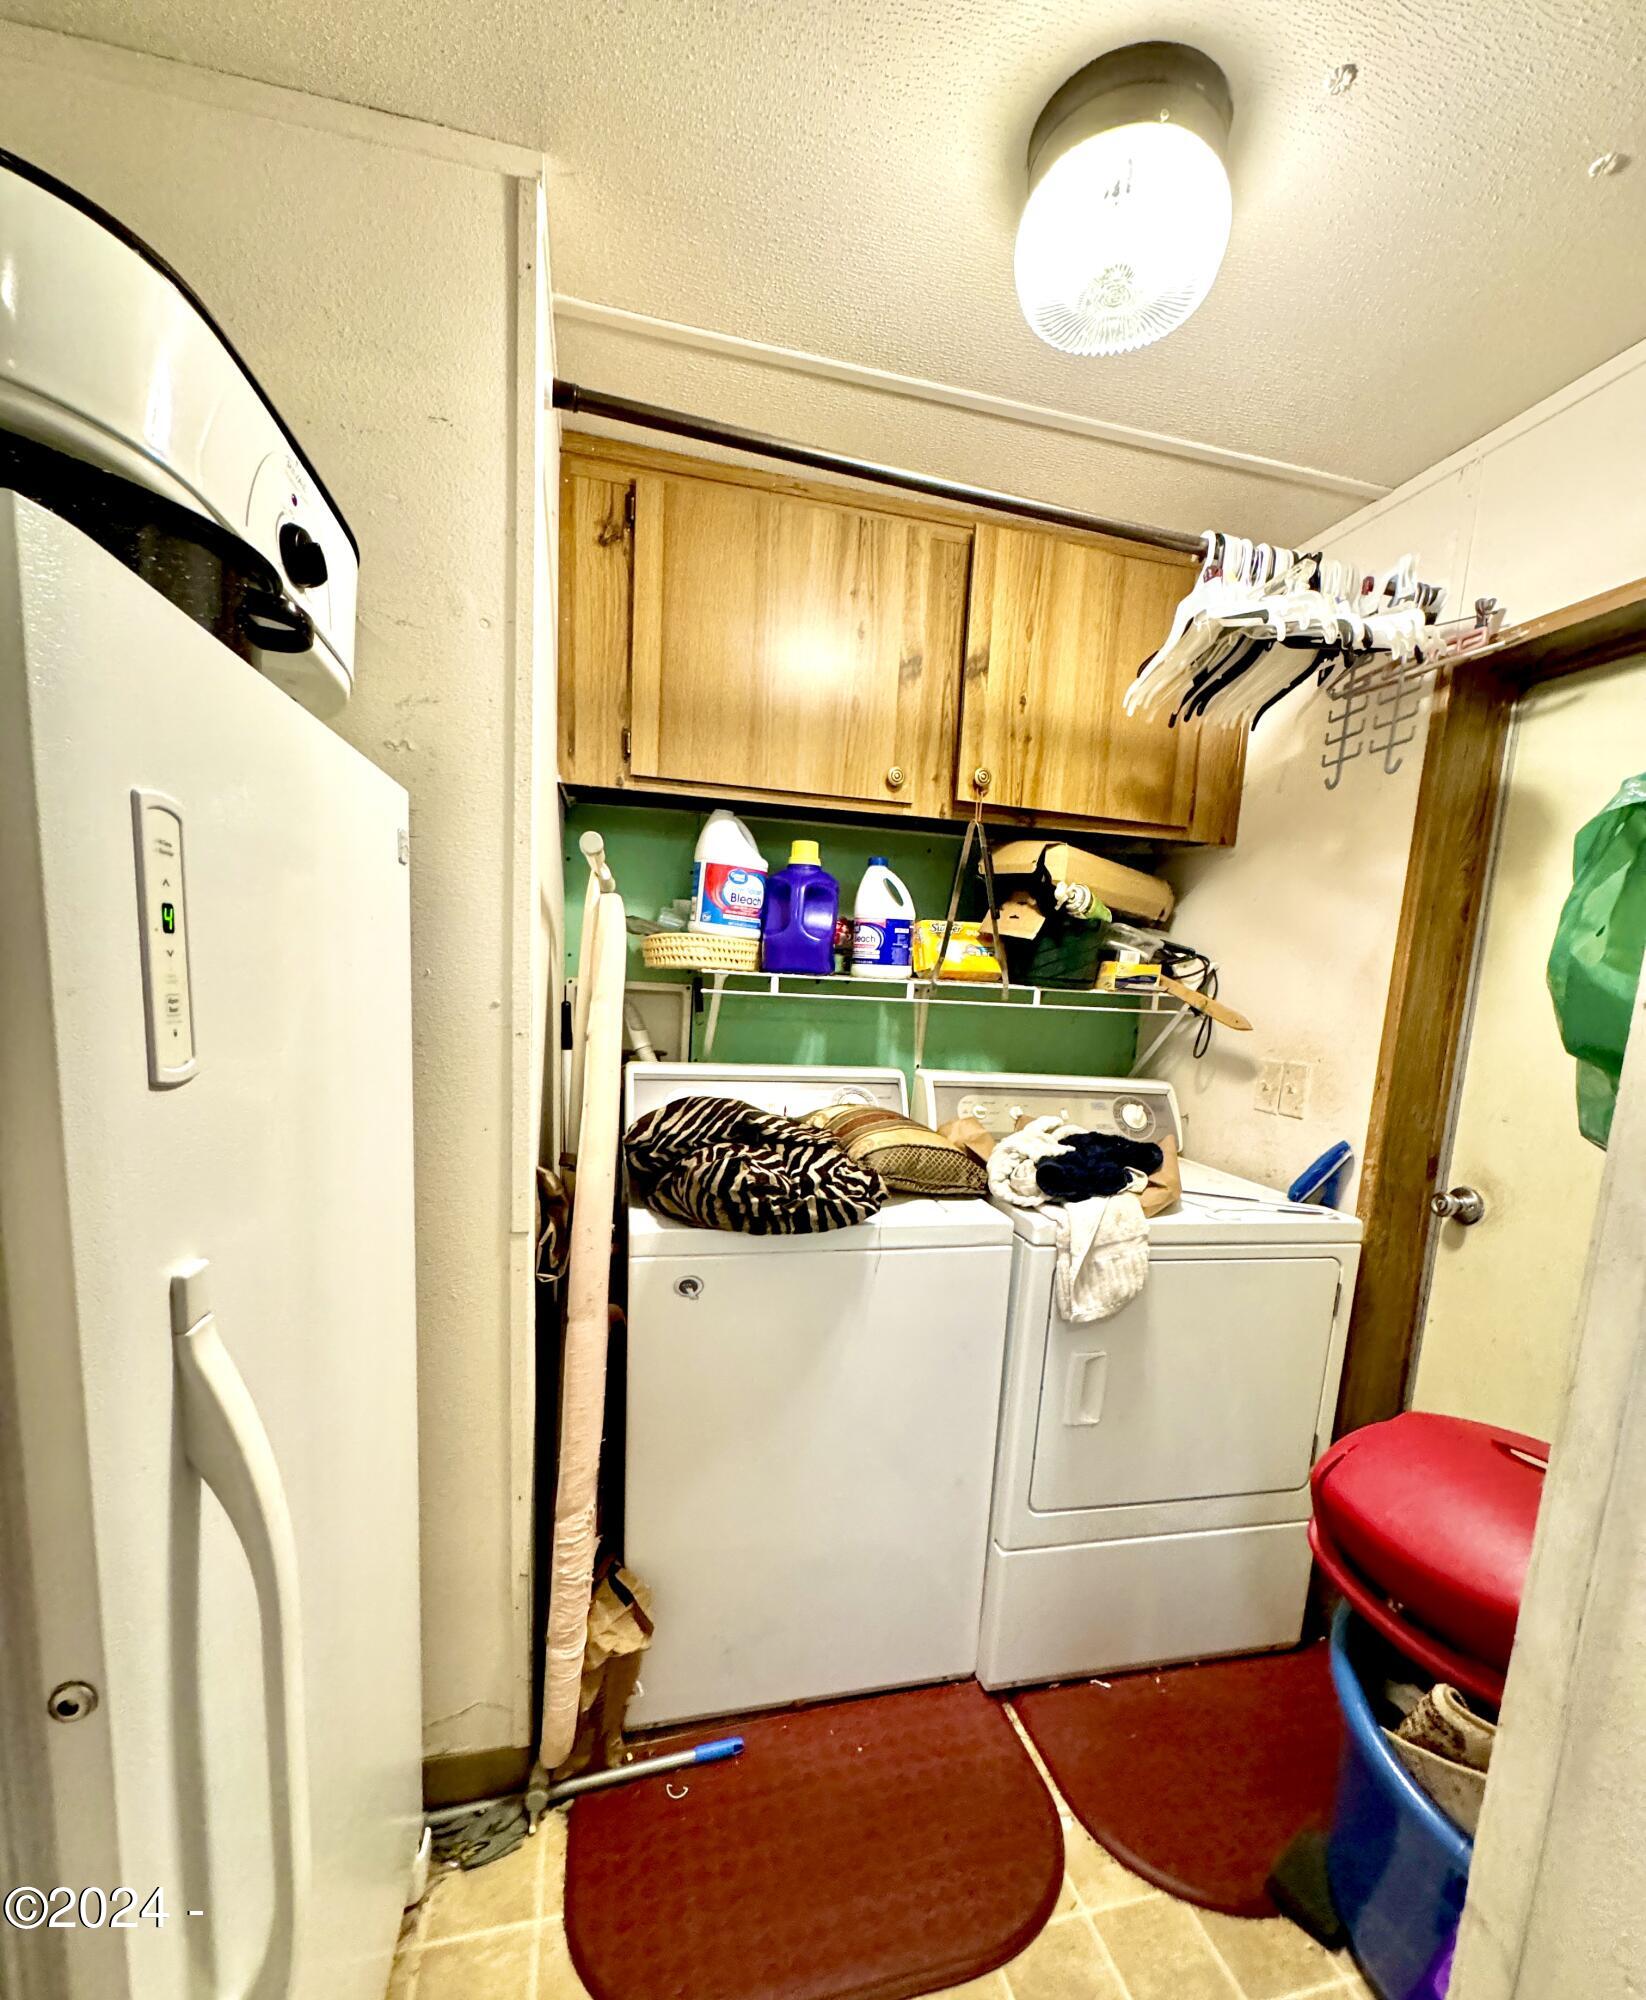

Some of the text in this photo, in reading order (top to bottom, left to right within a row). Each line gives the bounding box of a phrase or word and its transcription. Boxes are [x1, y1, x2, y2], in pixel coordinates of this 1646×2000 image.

[730, 892, 762, 906] Bleach
[164, 907, 173, 930] 4
[854, 935, 876, 943] leach
